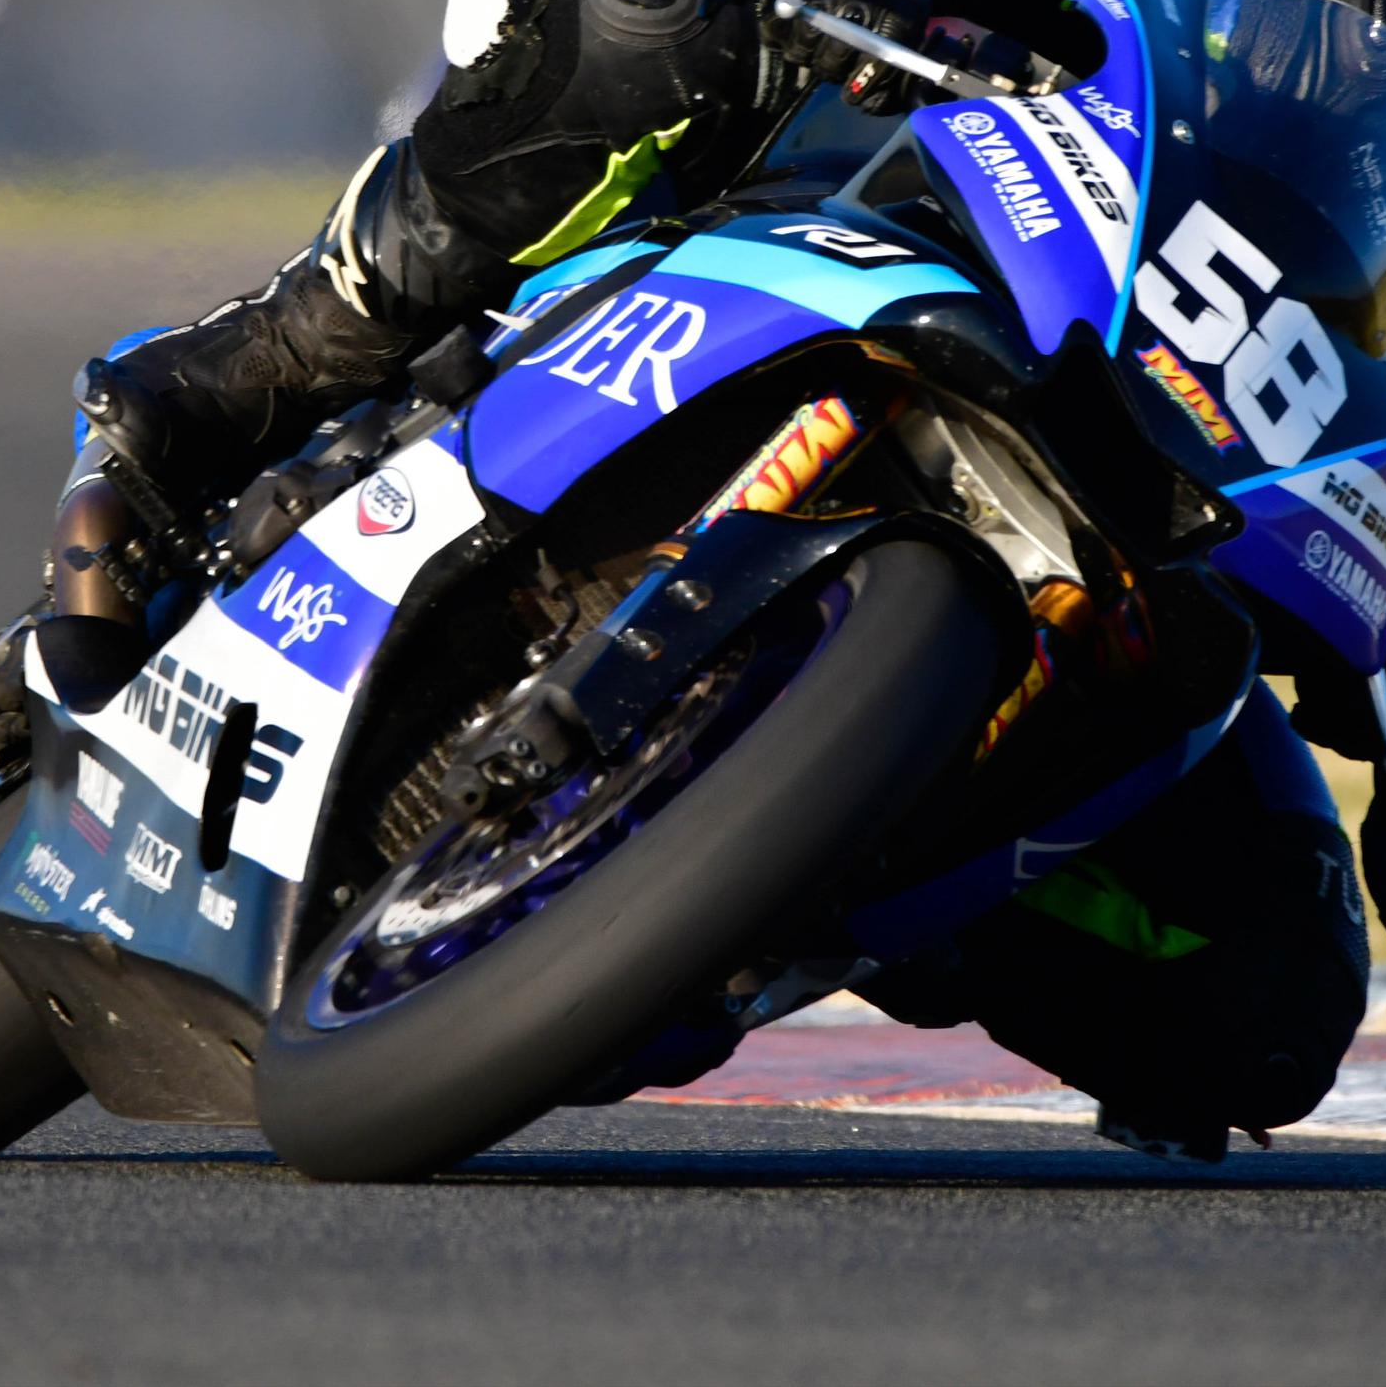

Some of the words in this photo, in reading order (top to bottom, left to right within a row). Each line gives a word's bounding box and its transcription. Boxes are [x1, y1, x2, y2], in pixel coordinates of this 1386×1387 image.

[974, 131, 1062, 238] YAMAHA
[1133, 200, 1347, 469] 58
[1136, 341, 1243, 455] MM
[1322, 471, 1366, 517] MG
